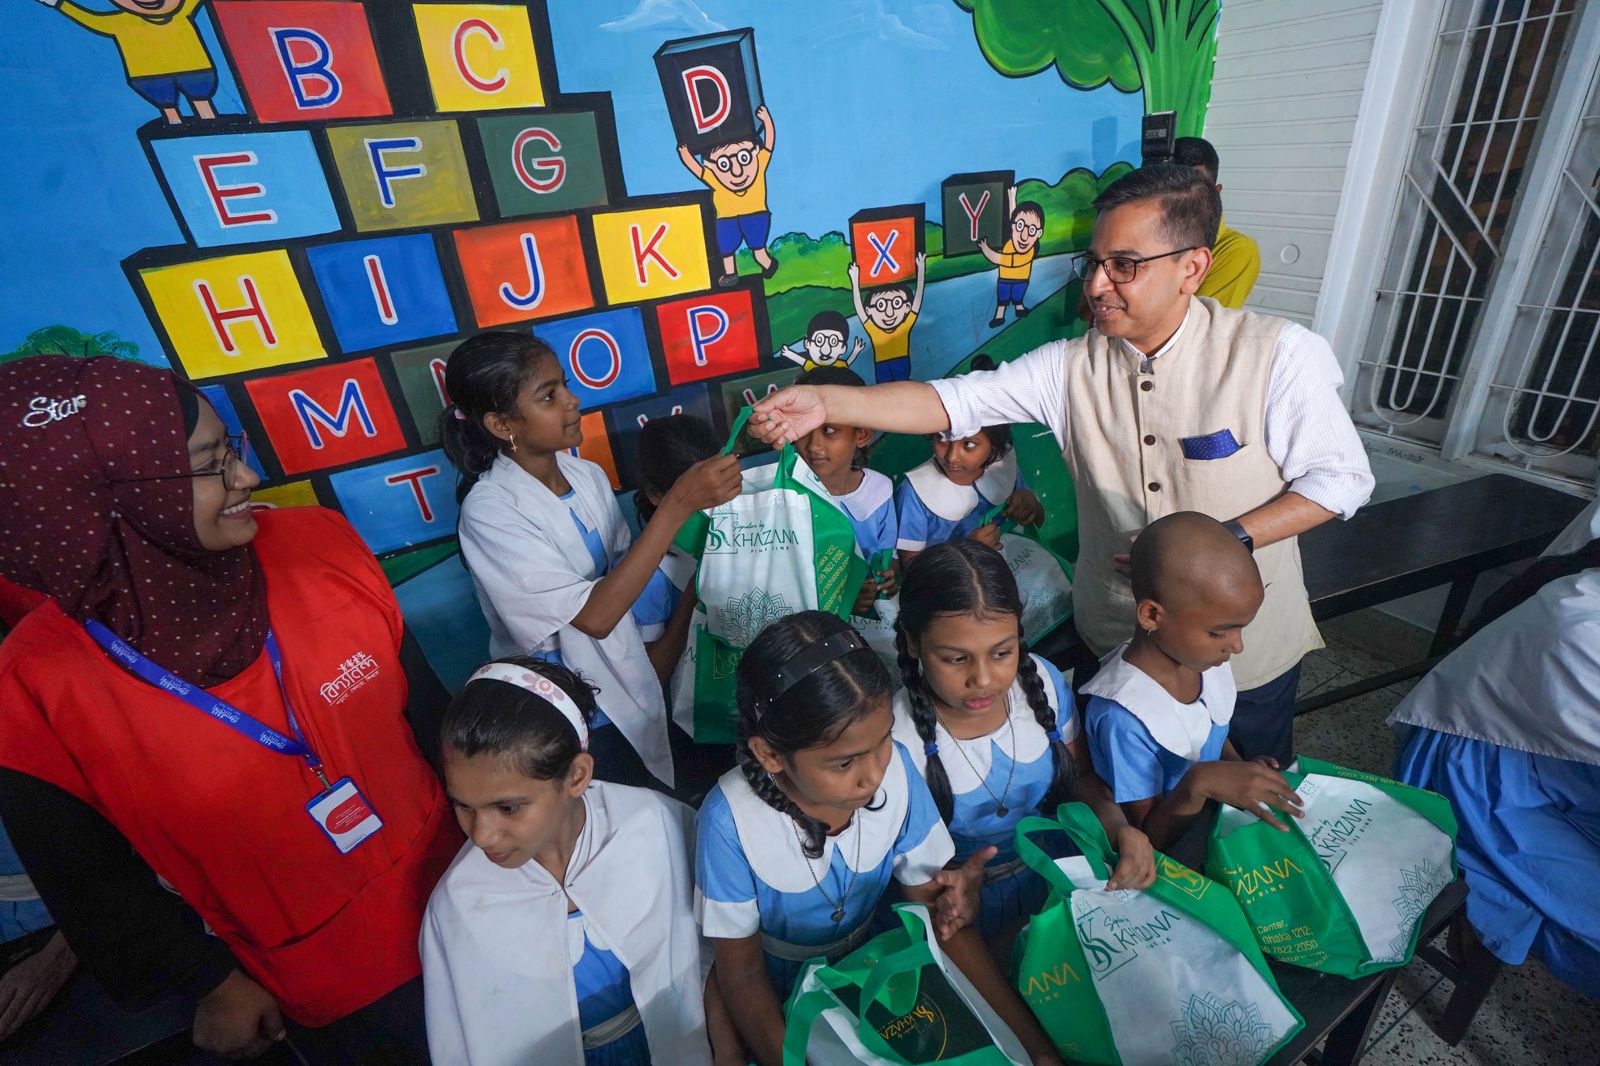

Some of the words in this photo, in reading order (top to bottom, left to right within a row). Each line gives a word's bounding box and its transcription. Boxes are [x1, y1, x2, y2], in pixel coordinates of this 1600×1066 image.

[268, 27, 343, 111] B
[451, 18, 507, 94] C
[681, 65, 732, 135] D
[193, 151, 279, 230] E
[364, 136, 427, 209] F
[511, 126, 567, 194] G
[959, 190, 991, 241] Y
[867, 229, 901, 278] X
[193, 275, 280, 358] H
[364, 255, 399, 325] I
[500, 233, 546, 311] J
[629, 221, 683, 287] K
[289, 378, 378, 450] M
[569, 328, 622, 390] O
[686, 305, 730, 367] P
[23, 395, 86, 427] Star
[384, 465, 441, 524] T
[733, 529, 799, 548] KHAZANA
[1008, 548, 1035, 572] ZANA
[1318, 799, 1373, 853] KHAZANA
[1235, 858, 1303, 897] AZANA
[1295, 939, 1319, 953] 2050
[880, 1014, 915, 1040] KHAZA
